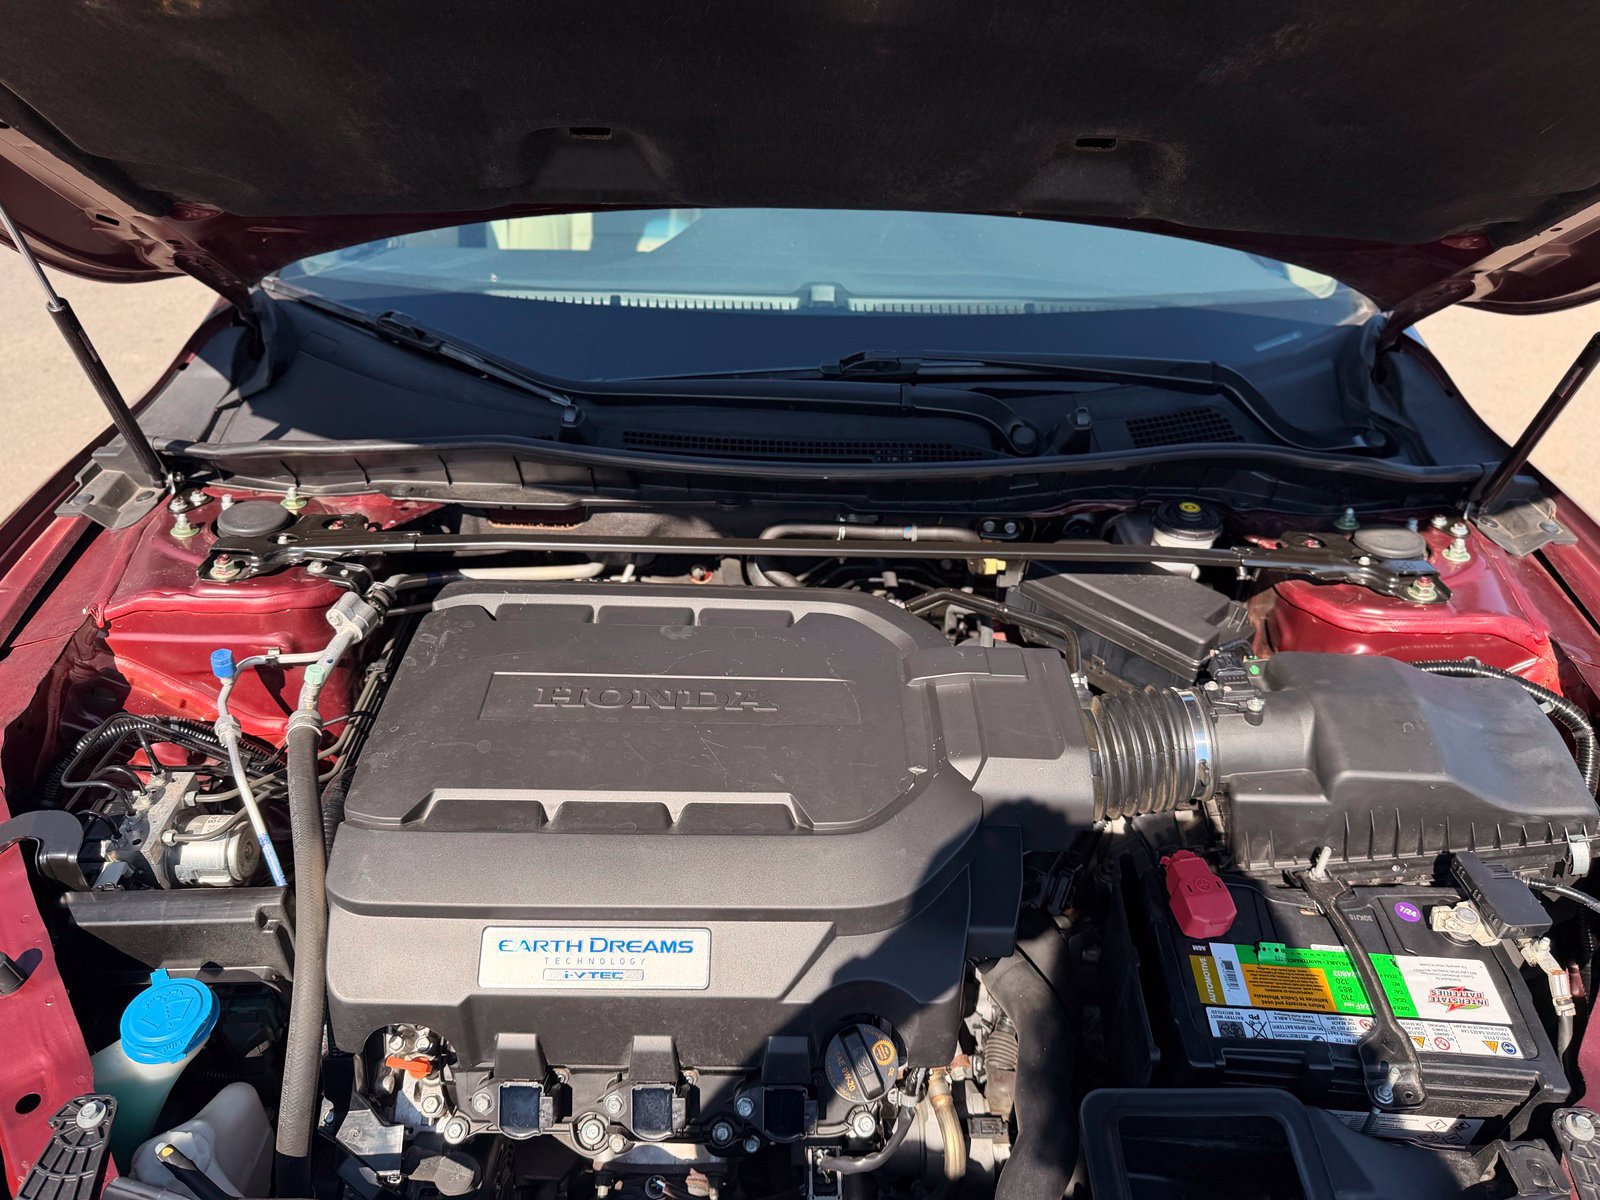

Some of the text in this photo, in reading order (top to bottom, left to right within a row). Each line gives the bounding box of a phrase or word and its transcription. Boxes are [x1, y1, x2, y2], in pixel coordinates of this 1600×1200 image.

[533, 687, 779, 711] HONDA
[1399, 904, 1417, 918] 7/24
[499, 938, 694, 954] EARTH DREAMS
[1192, 944, 1206, 952] AGM
[544, 957, 646, 965] TECHNOLOGY
[564, 970, 624, 980] i-VTEC
[1199, 956, 1217, 1004] AUTOMOTIVE
[1430, 989, 1483, 998] BATTERIES
[1429, 996, 1488, 1006] INTERSTATE
[163, 1041, 187, 1053] PULL
[834, 1050, 845, 1067] SAE
[841, 1067, 857, 1092] 0W-20
